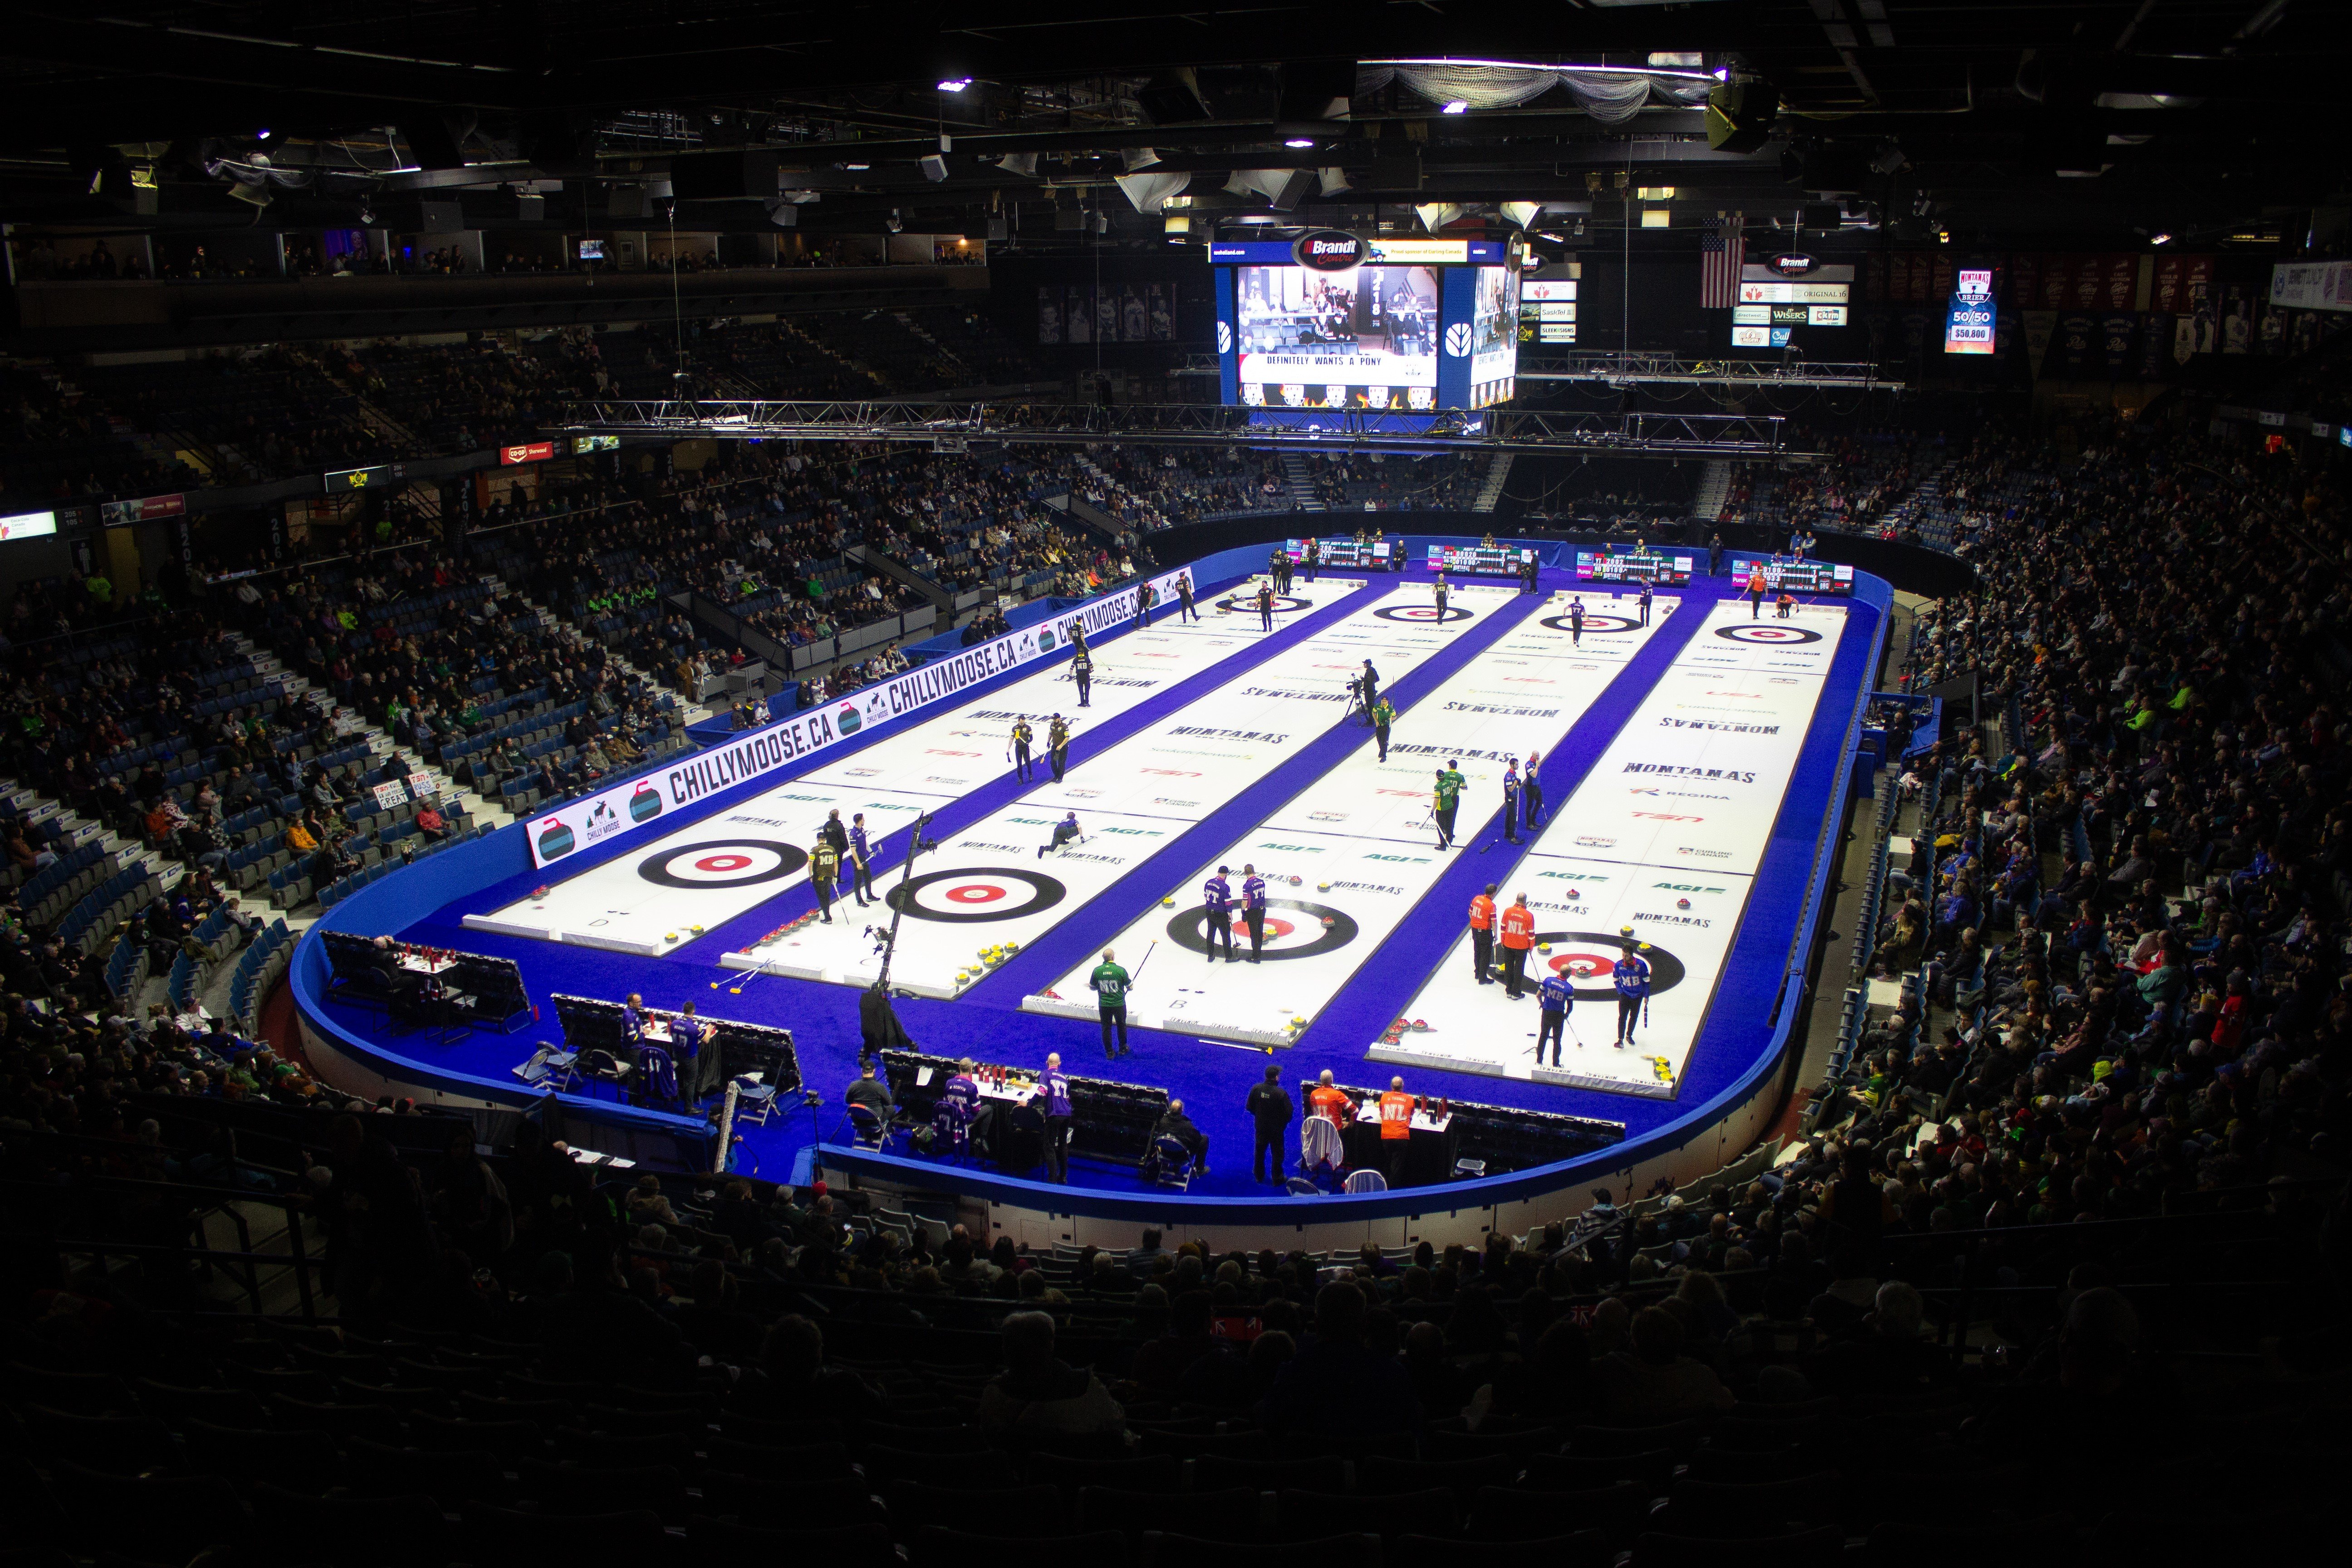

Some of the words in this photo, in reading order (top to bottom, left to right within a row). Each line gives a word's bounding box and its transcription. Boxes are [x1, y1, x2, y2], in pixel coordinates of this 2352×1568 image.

[1313, 240, 1357, 254] Brandt
[1317, 252, 1354, 265] Centre
[1781, 258, 1809, 267] Brandt
[1773, 310, 1807, 319] WISER'S
[1953, 311, 1990, 323] 50/50
[1955, 328, 1985, 339] $50,800
[1267, 356, 1309, 366] DEFINITELY
[1315, 356, 1344, 366] WANTS
[1349, 357, 1355, 366] A
[1360, 357, 1381, 367] PONY
[888, 639, 1017, 715] CHILLYMOOSE.CA
[867, 713, 877, 724] CHILLY
[877, 709, 889, 720] MOOSE
[669, 713, 834, 805] CHILLYMOOSE.CA
[1139, 768, 1203, 777] TSN
[414, 781, 431, 790] RUSS
[380, 793, 407, 808] GREAT
[1666, 791, 1730, 800] REGINA
[1004, 818, 1049, 826] AGI
[1631, 812, 1704, 823] TSN
[587, 827, 602, 841] CHILLY
[603, 821, 621, 835] MOOSE
[1098, 827, 1145, 836] AGI
[1257, 843, 1305, 852] AGI
[819, 854, 834, 866] MB
[1362, 853, 1409, 863] AGI
[1535, 871, 1586, 881] AGI
[1252, 887, 1264, 899] YT
[1651, 882, 1704, 892] AGI
[1205, 889, 1220, 904] YT
[1472, 905, 1483, 919] NL
[1525, 900, 1590, 916] ONTANA'S
[1508, 920, 1526, 935] NL
[1098, 980, 1119, 994] NO
[1622, 975, 1640, 987] MB
[1547, 988, 1564, 1001] MB
[1169, 1000, 1188, 1009] B
[1384, 1104, 1408, 1121] NL
